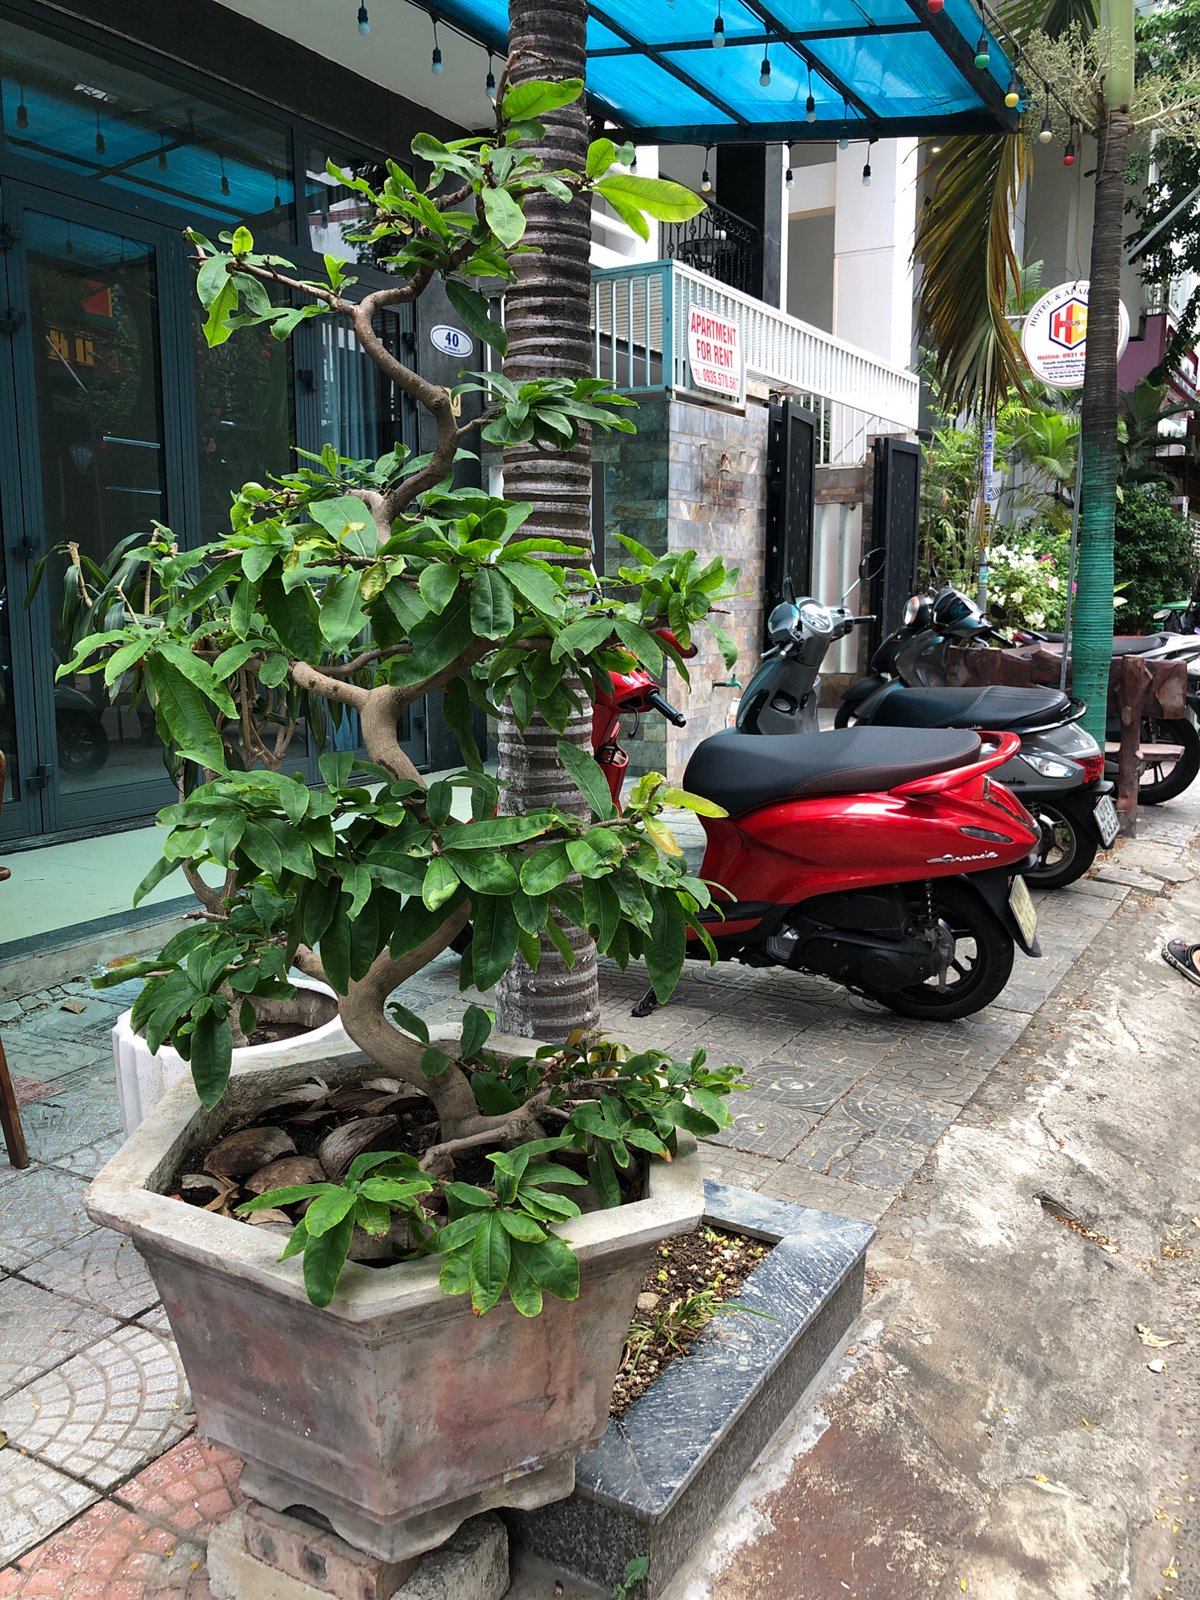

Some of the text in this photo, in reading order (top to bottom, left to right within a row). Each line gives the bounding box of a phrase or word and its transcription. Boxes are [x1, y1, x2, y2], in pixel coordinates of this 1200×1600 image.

[1030, 299, 1053, 327] HOTEL
[1064, 288, 1089, 297] APAR
[445, 331, 459, 347] 40
[691, 312, 736, 347] APARTMENT
[696, 339, 734, 368] FOR RENT
